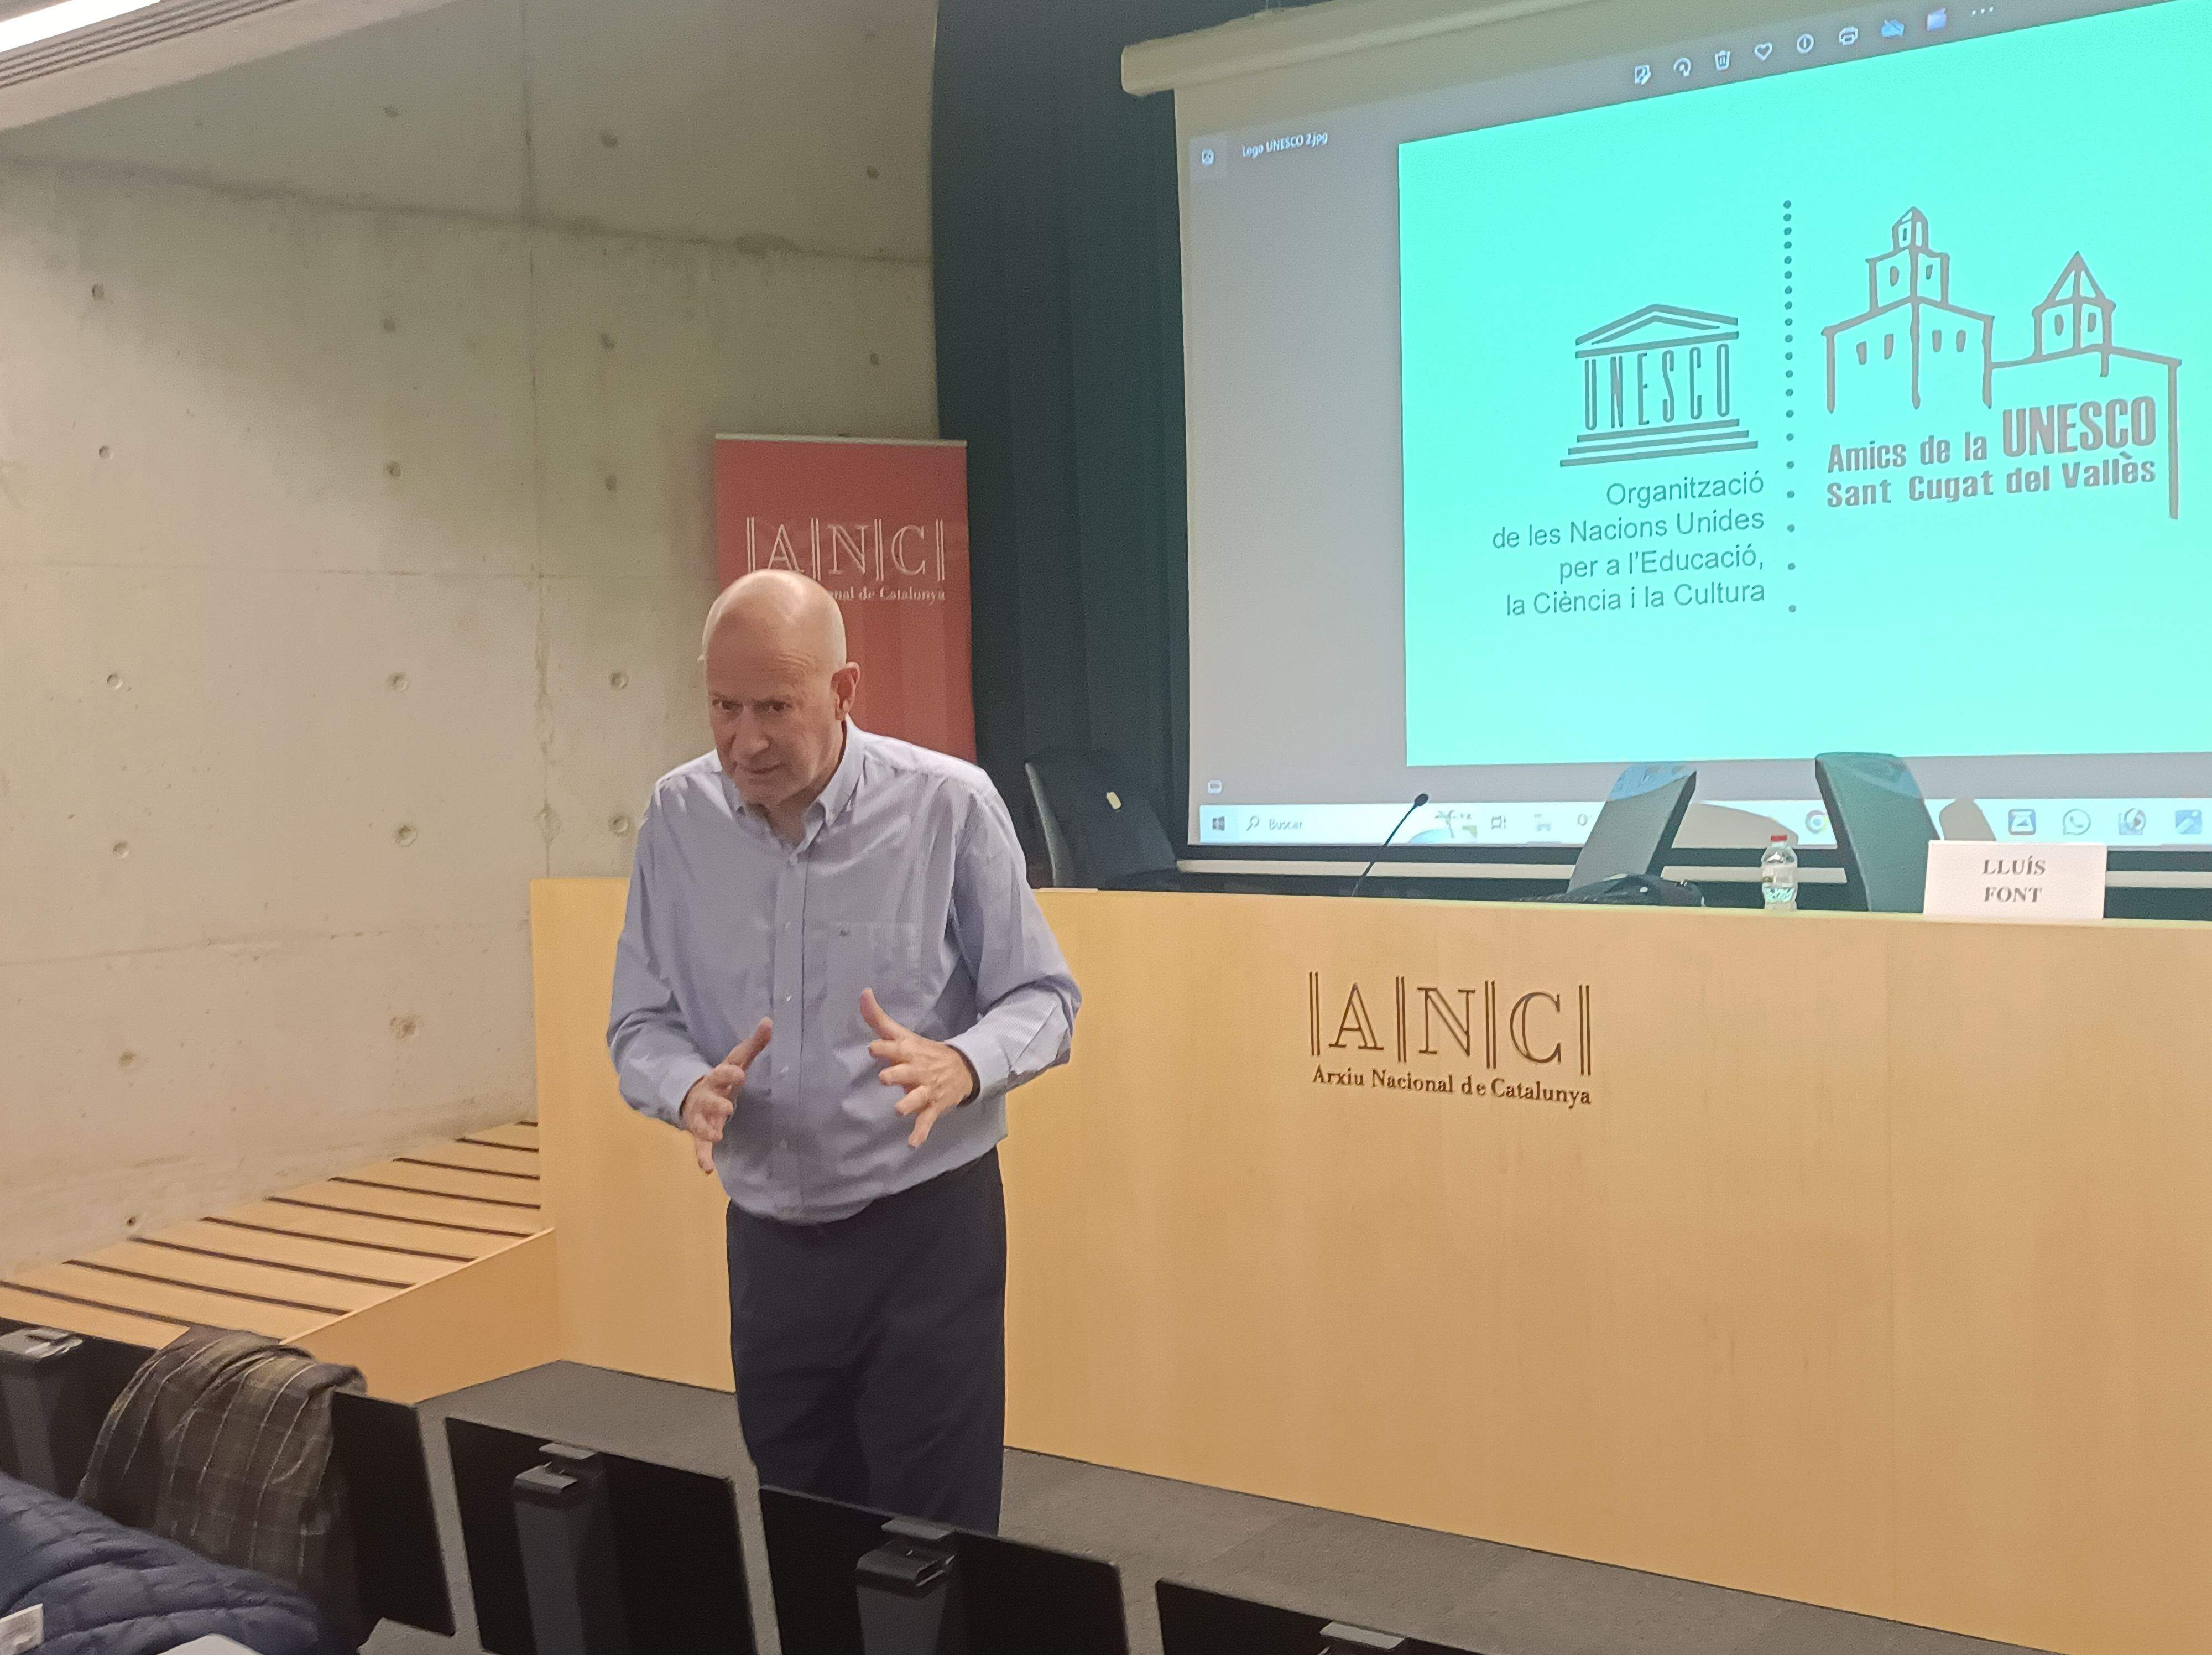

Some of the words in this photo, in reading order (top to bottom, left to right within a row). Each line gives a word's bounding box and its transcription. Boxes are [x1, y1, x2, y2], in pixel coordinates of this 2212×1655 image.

[1243, 144, 1264, 159] Logo
[1266, 134, 1303, 153] UNESCO
[1584, 344, 1730, 430] UNESCO
[1827, 440, 1906, 473] Amics
[1919, 435, 1950, 465] de
[1964, 431, 1987, 461] la
[2002, 396, 2156, 457] UNESCO
[1606, 470, 1764, 509] Organització
[1827, 479, 1891, 507] Sant
[1908, 470, 1994, 503] Cugat
[2006, 465, 2050, 493] del
[2061, 451, 2156, 488] Vallès
[1493, 527, 1520, 549] de
[1528, 524, 1561, 547] les
[1571, 517, 1667, 543] Nacions
[1677, 509, 1764, 534] Unides
[1560, 559, 1598, 584] per
[1606, 559, 1620, 576] a
[1629, 544, 1764, 574] l'Educació,
[859, 586, 874, 600] de
[879, 586, 945, 605] Catalunya
[1507, 594, 1525, 616] la
[1533, 589, 1621, 614] Ciència
[1631, 586, 1635, 608] i
[1645, 586, 1665, 607] la
[1674, 582, 1765, 606] Cultura
[1269, 818, 1302, 830] Buscar
[1982, 855, 2046, 875] LLUÍS
[1984, 887, 2043, 903] FONT
[1313, 1064, 1364, 1086] Arxiu
[1372, 1069, 1453, 1094] Nacional
[1462, 1076, 1486, 1095] de
[1491, 1078, 1592, 1109] Catalunya
